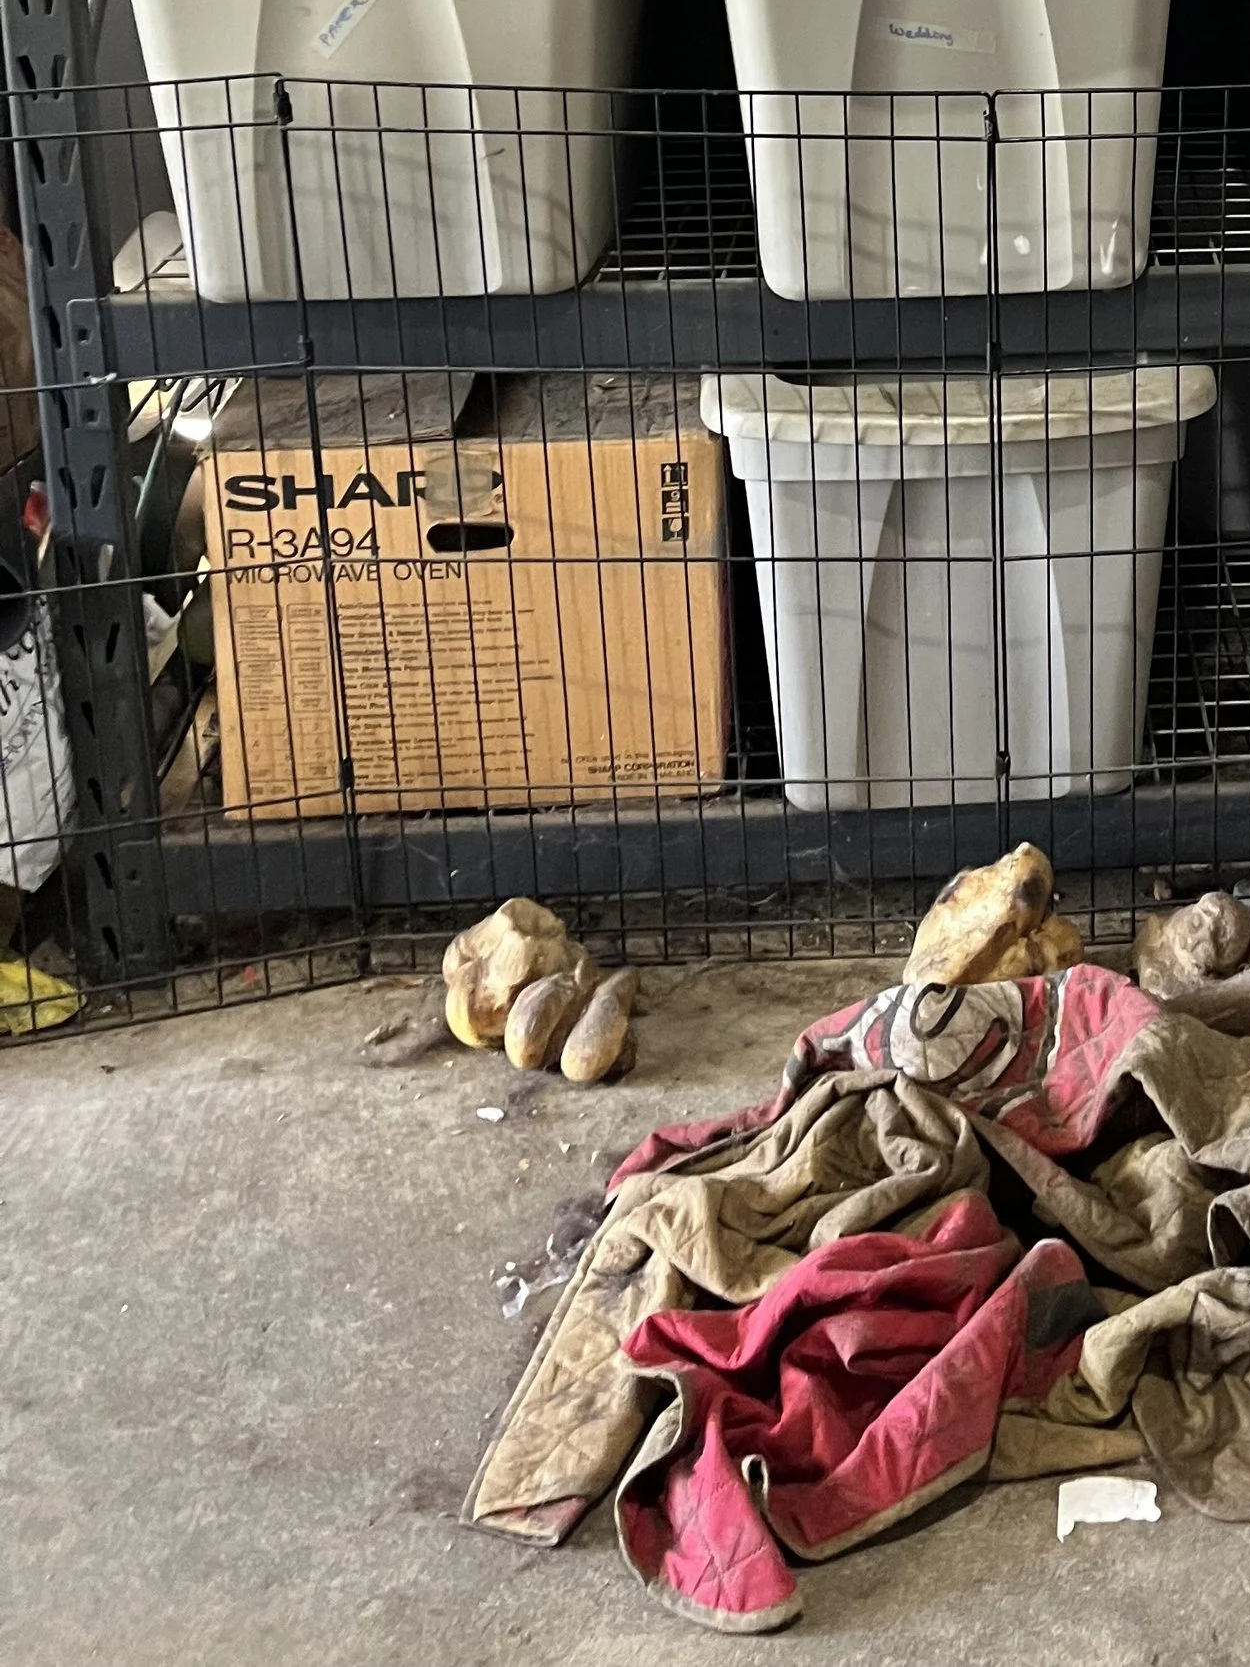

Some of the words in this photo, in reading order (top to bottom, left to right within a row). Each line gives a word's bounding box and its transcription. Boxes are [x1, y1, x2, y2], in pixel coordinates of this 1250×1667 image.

[227, 526, 381, 560] R-3A94
[228, 562, 380, 585] MICROWAVE
[393, 560, 462, 581] OVEN
[624, 760, 695, 772] CORPRATION
